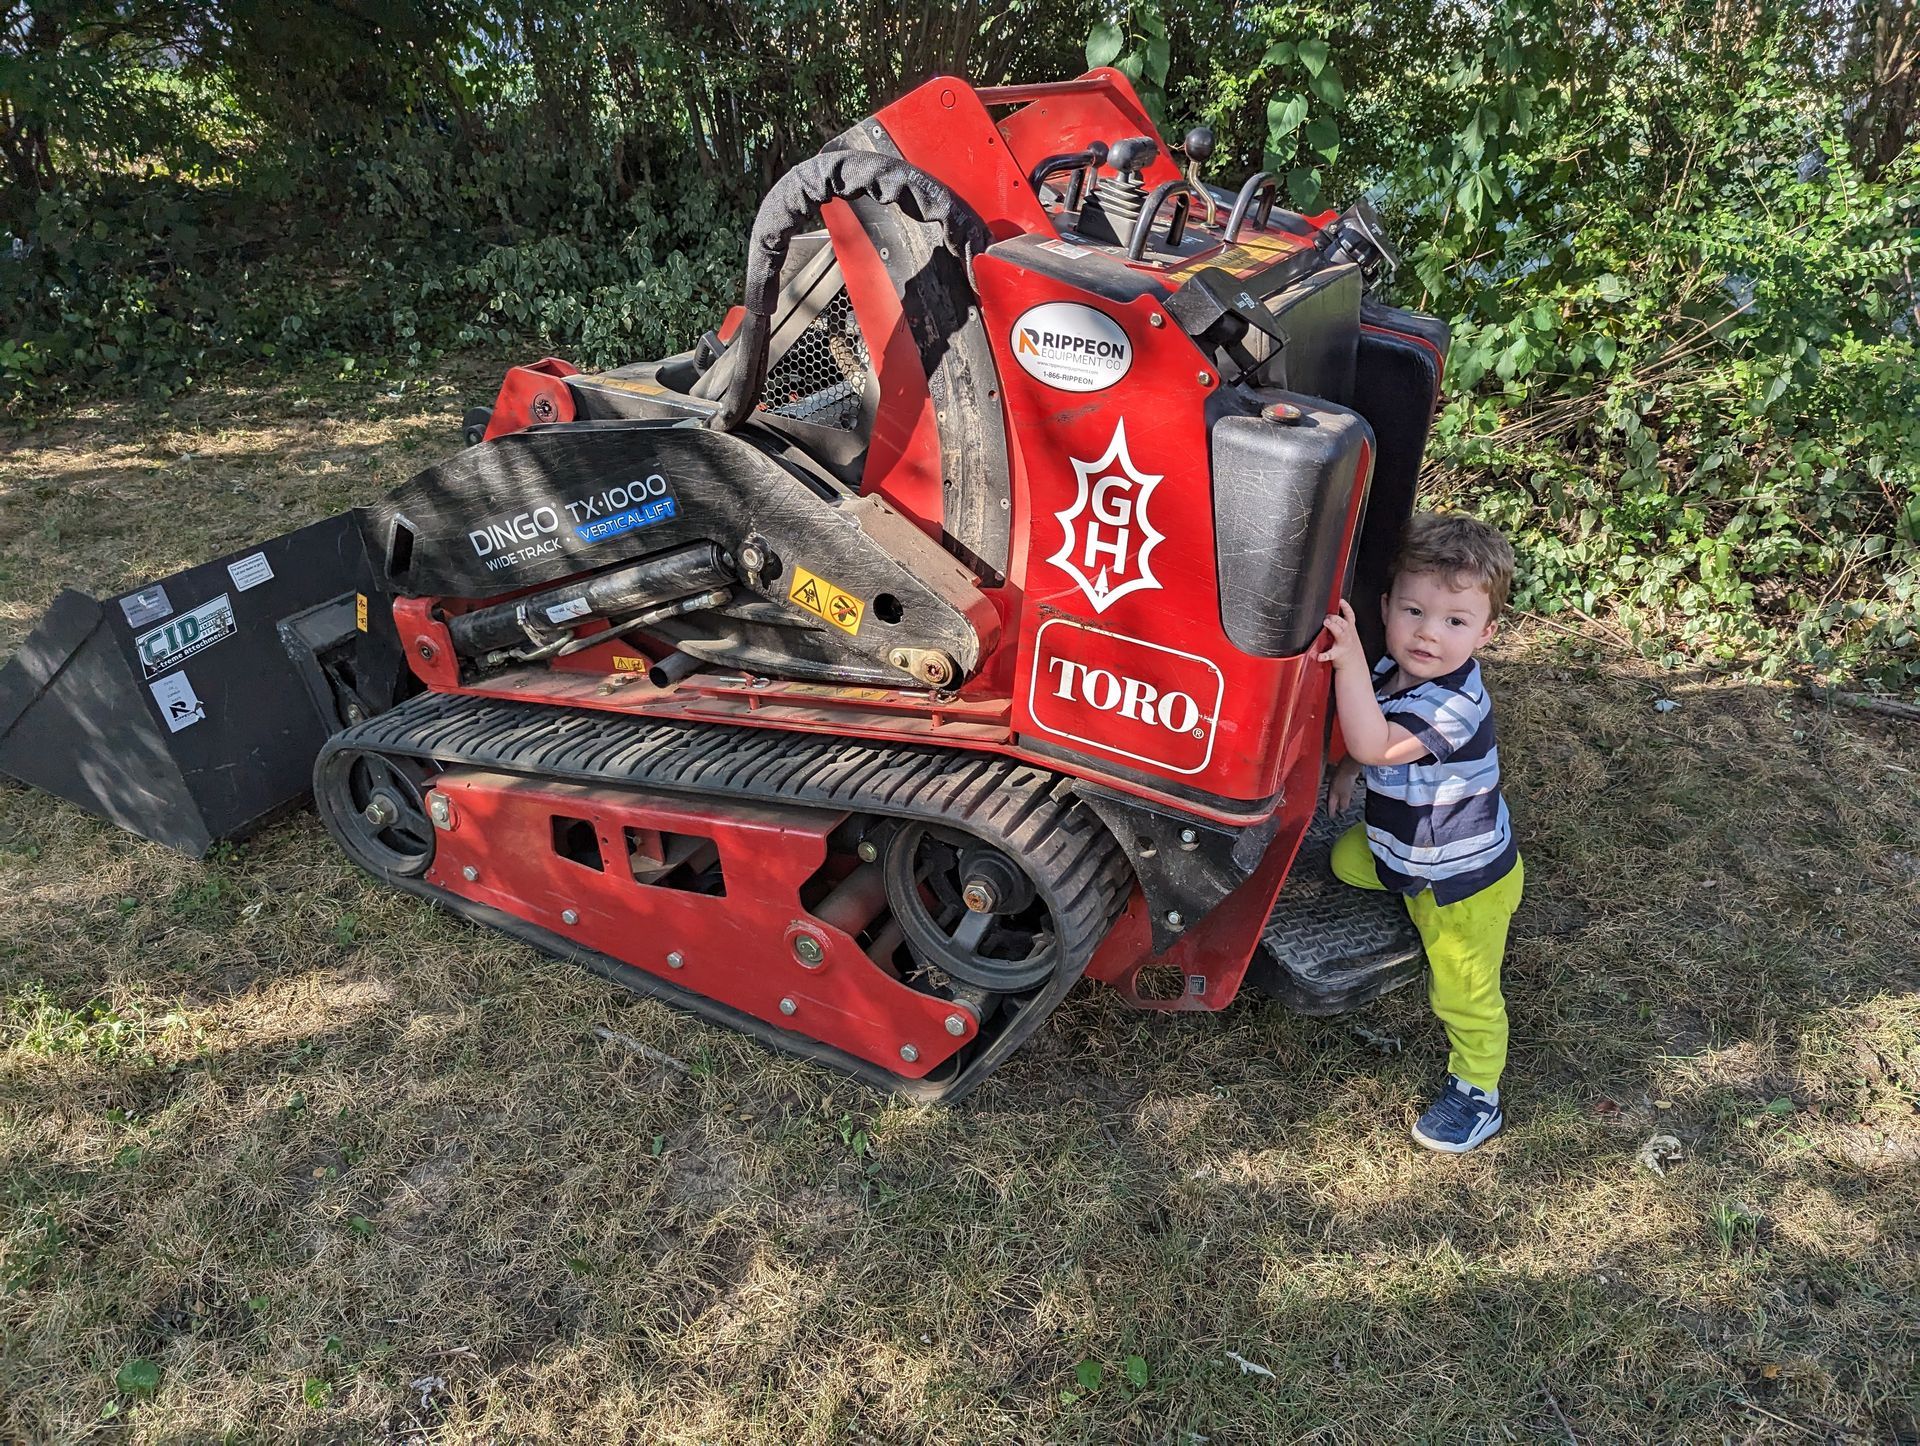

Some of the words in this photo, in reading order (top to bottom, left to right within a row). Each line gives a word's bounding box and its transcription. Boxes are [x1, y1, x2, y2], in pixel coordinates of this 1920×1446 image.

[1041, 347, 1103, 367] EQUIPMENT
[1105, 358, 1123, 372] CO.
[1042, 332, 1125, 360] RIPPEON
[468, 505, 560, 557] DINGO
[579, 510, 646, 541] VERTICAL
[645, 500, 674, 521] LIFT
[485, 554, 518, 573] WIDE
[517, 536, 563, 563] TRACK
[142, 614, 200, 665] CID
[1049, 656, 1199, 733] TORO
